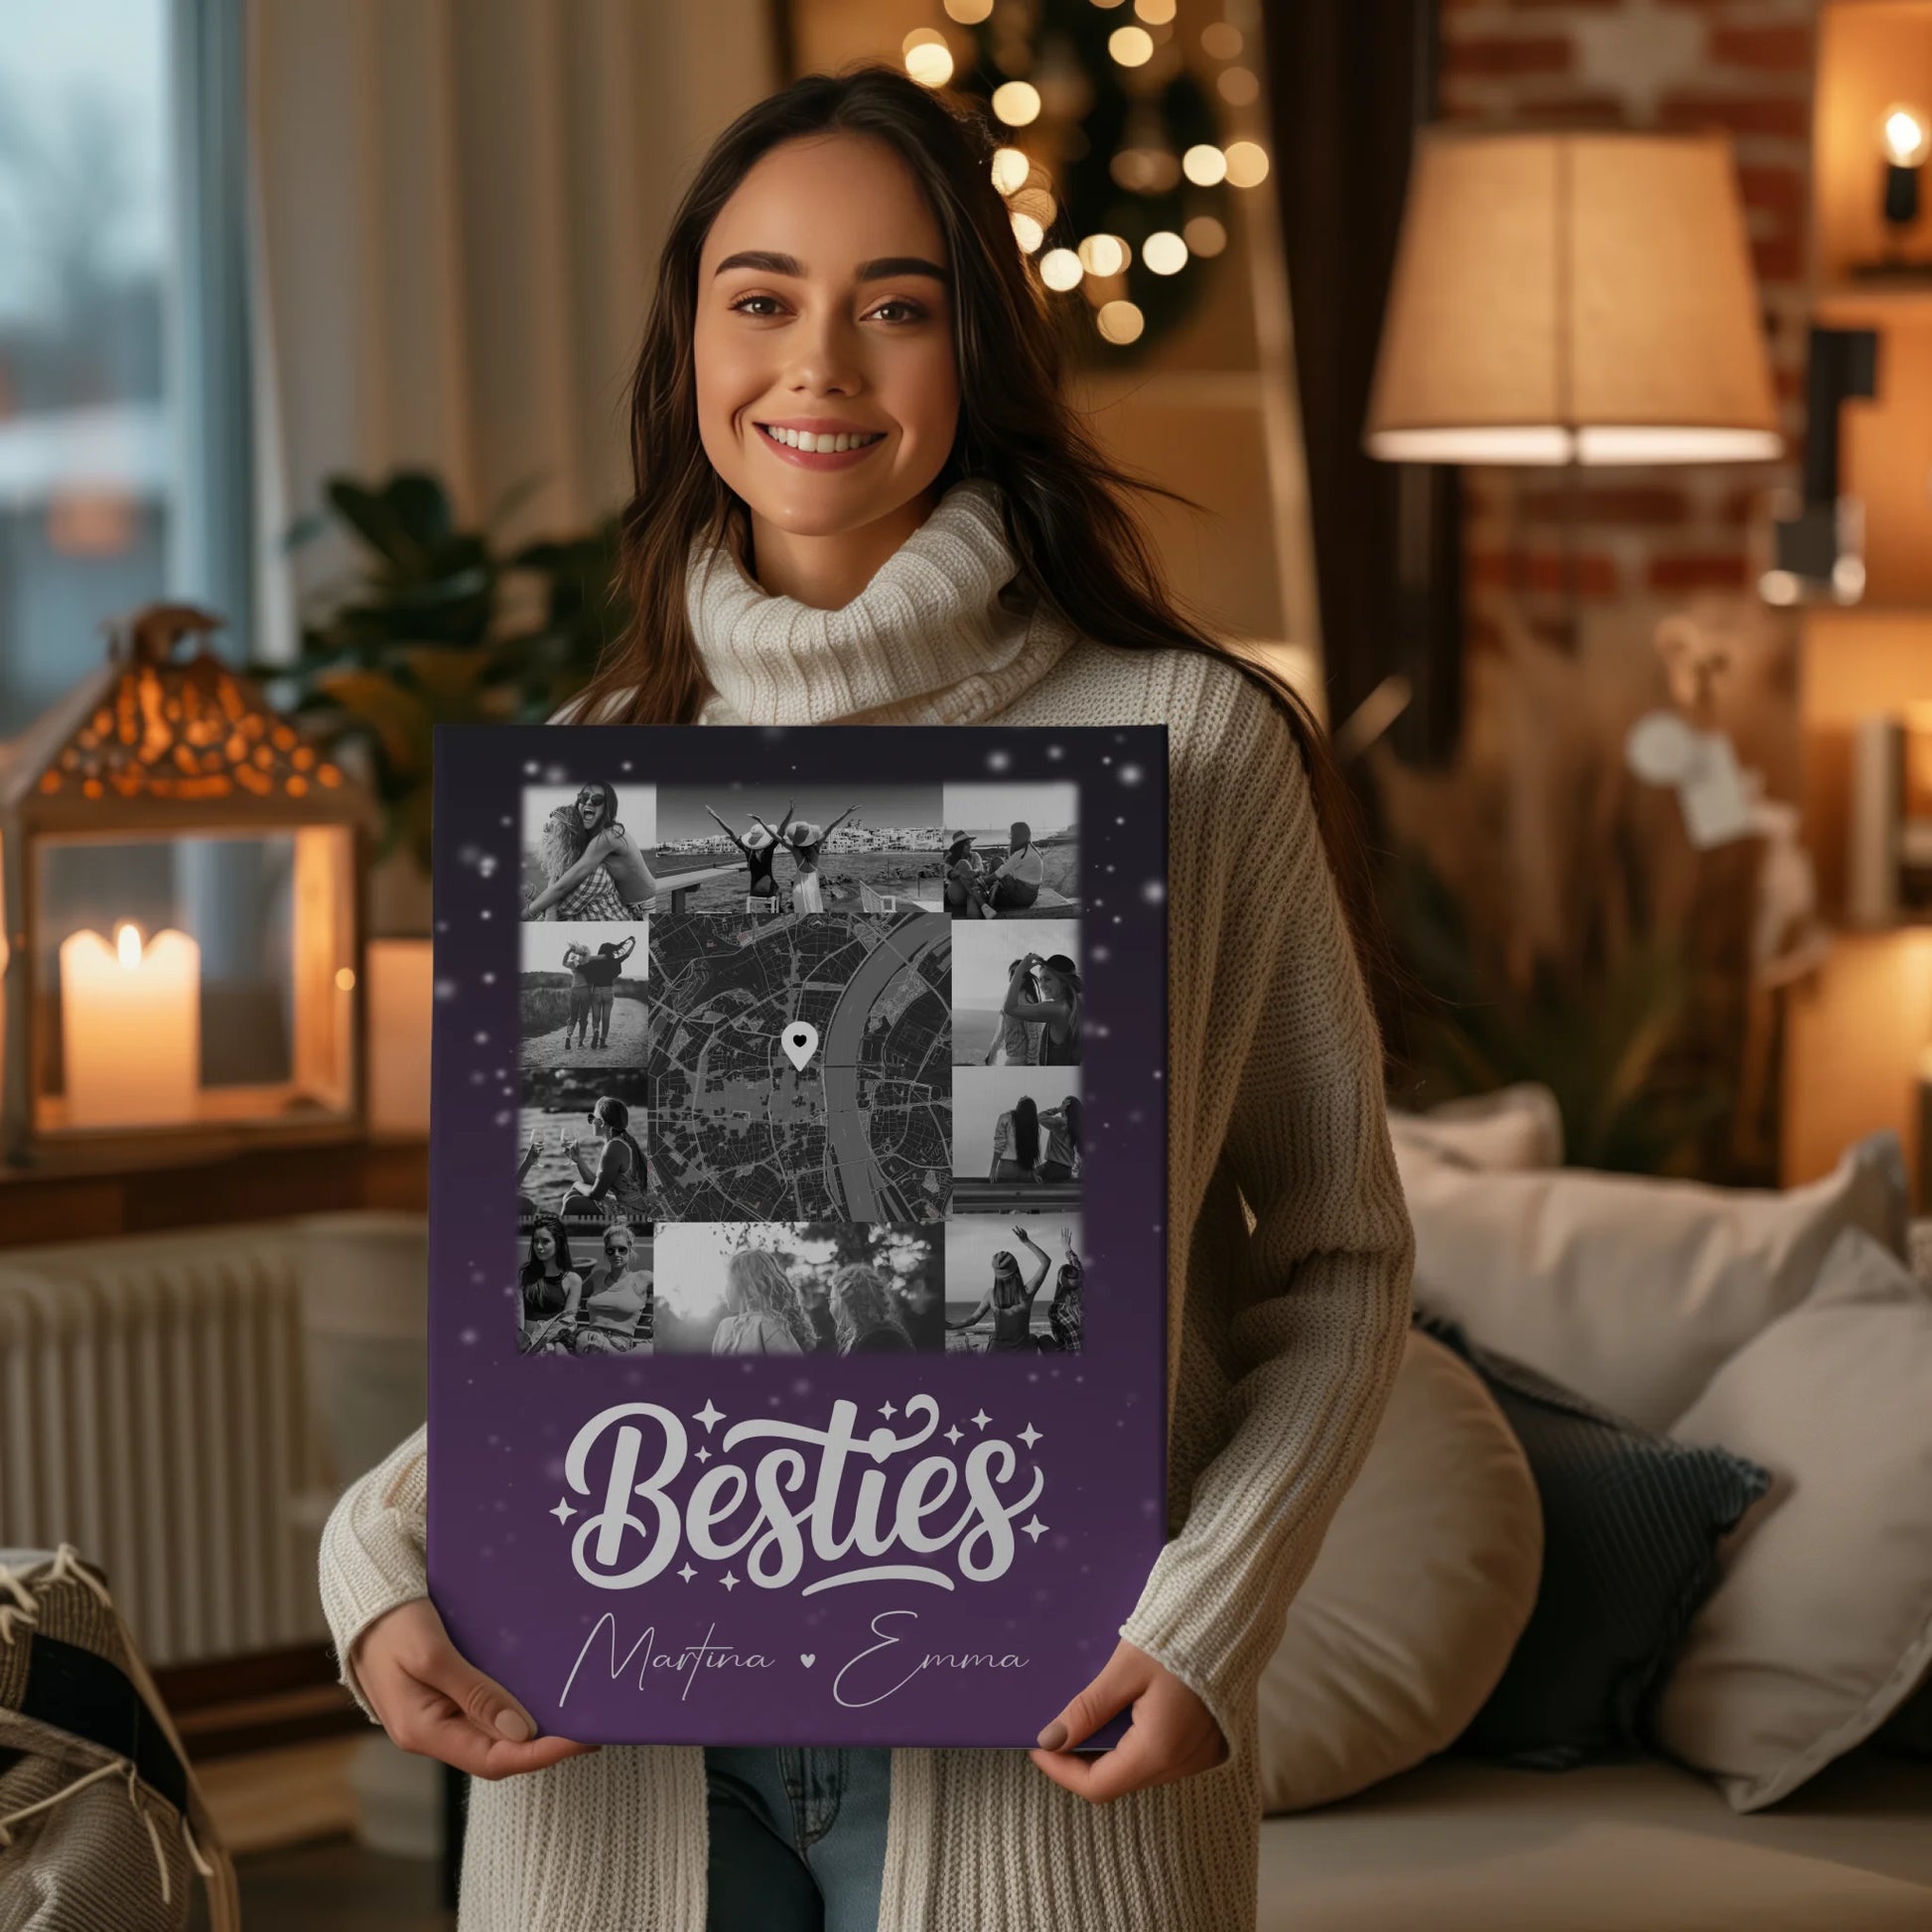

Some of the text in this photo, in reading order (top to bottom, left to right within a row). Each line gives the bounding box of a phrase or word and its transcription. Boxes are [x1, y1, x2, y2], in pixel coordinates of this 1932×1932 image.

[564, 1394, 1044, 1590] Besties
[558, 1609, 1030, 1708] Martina Emma
